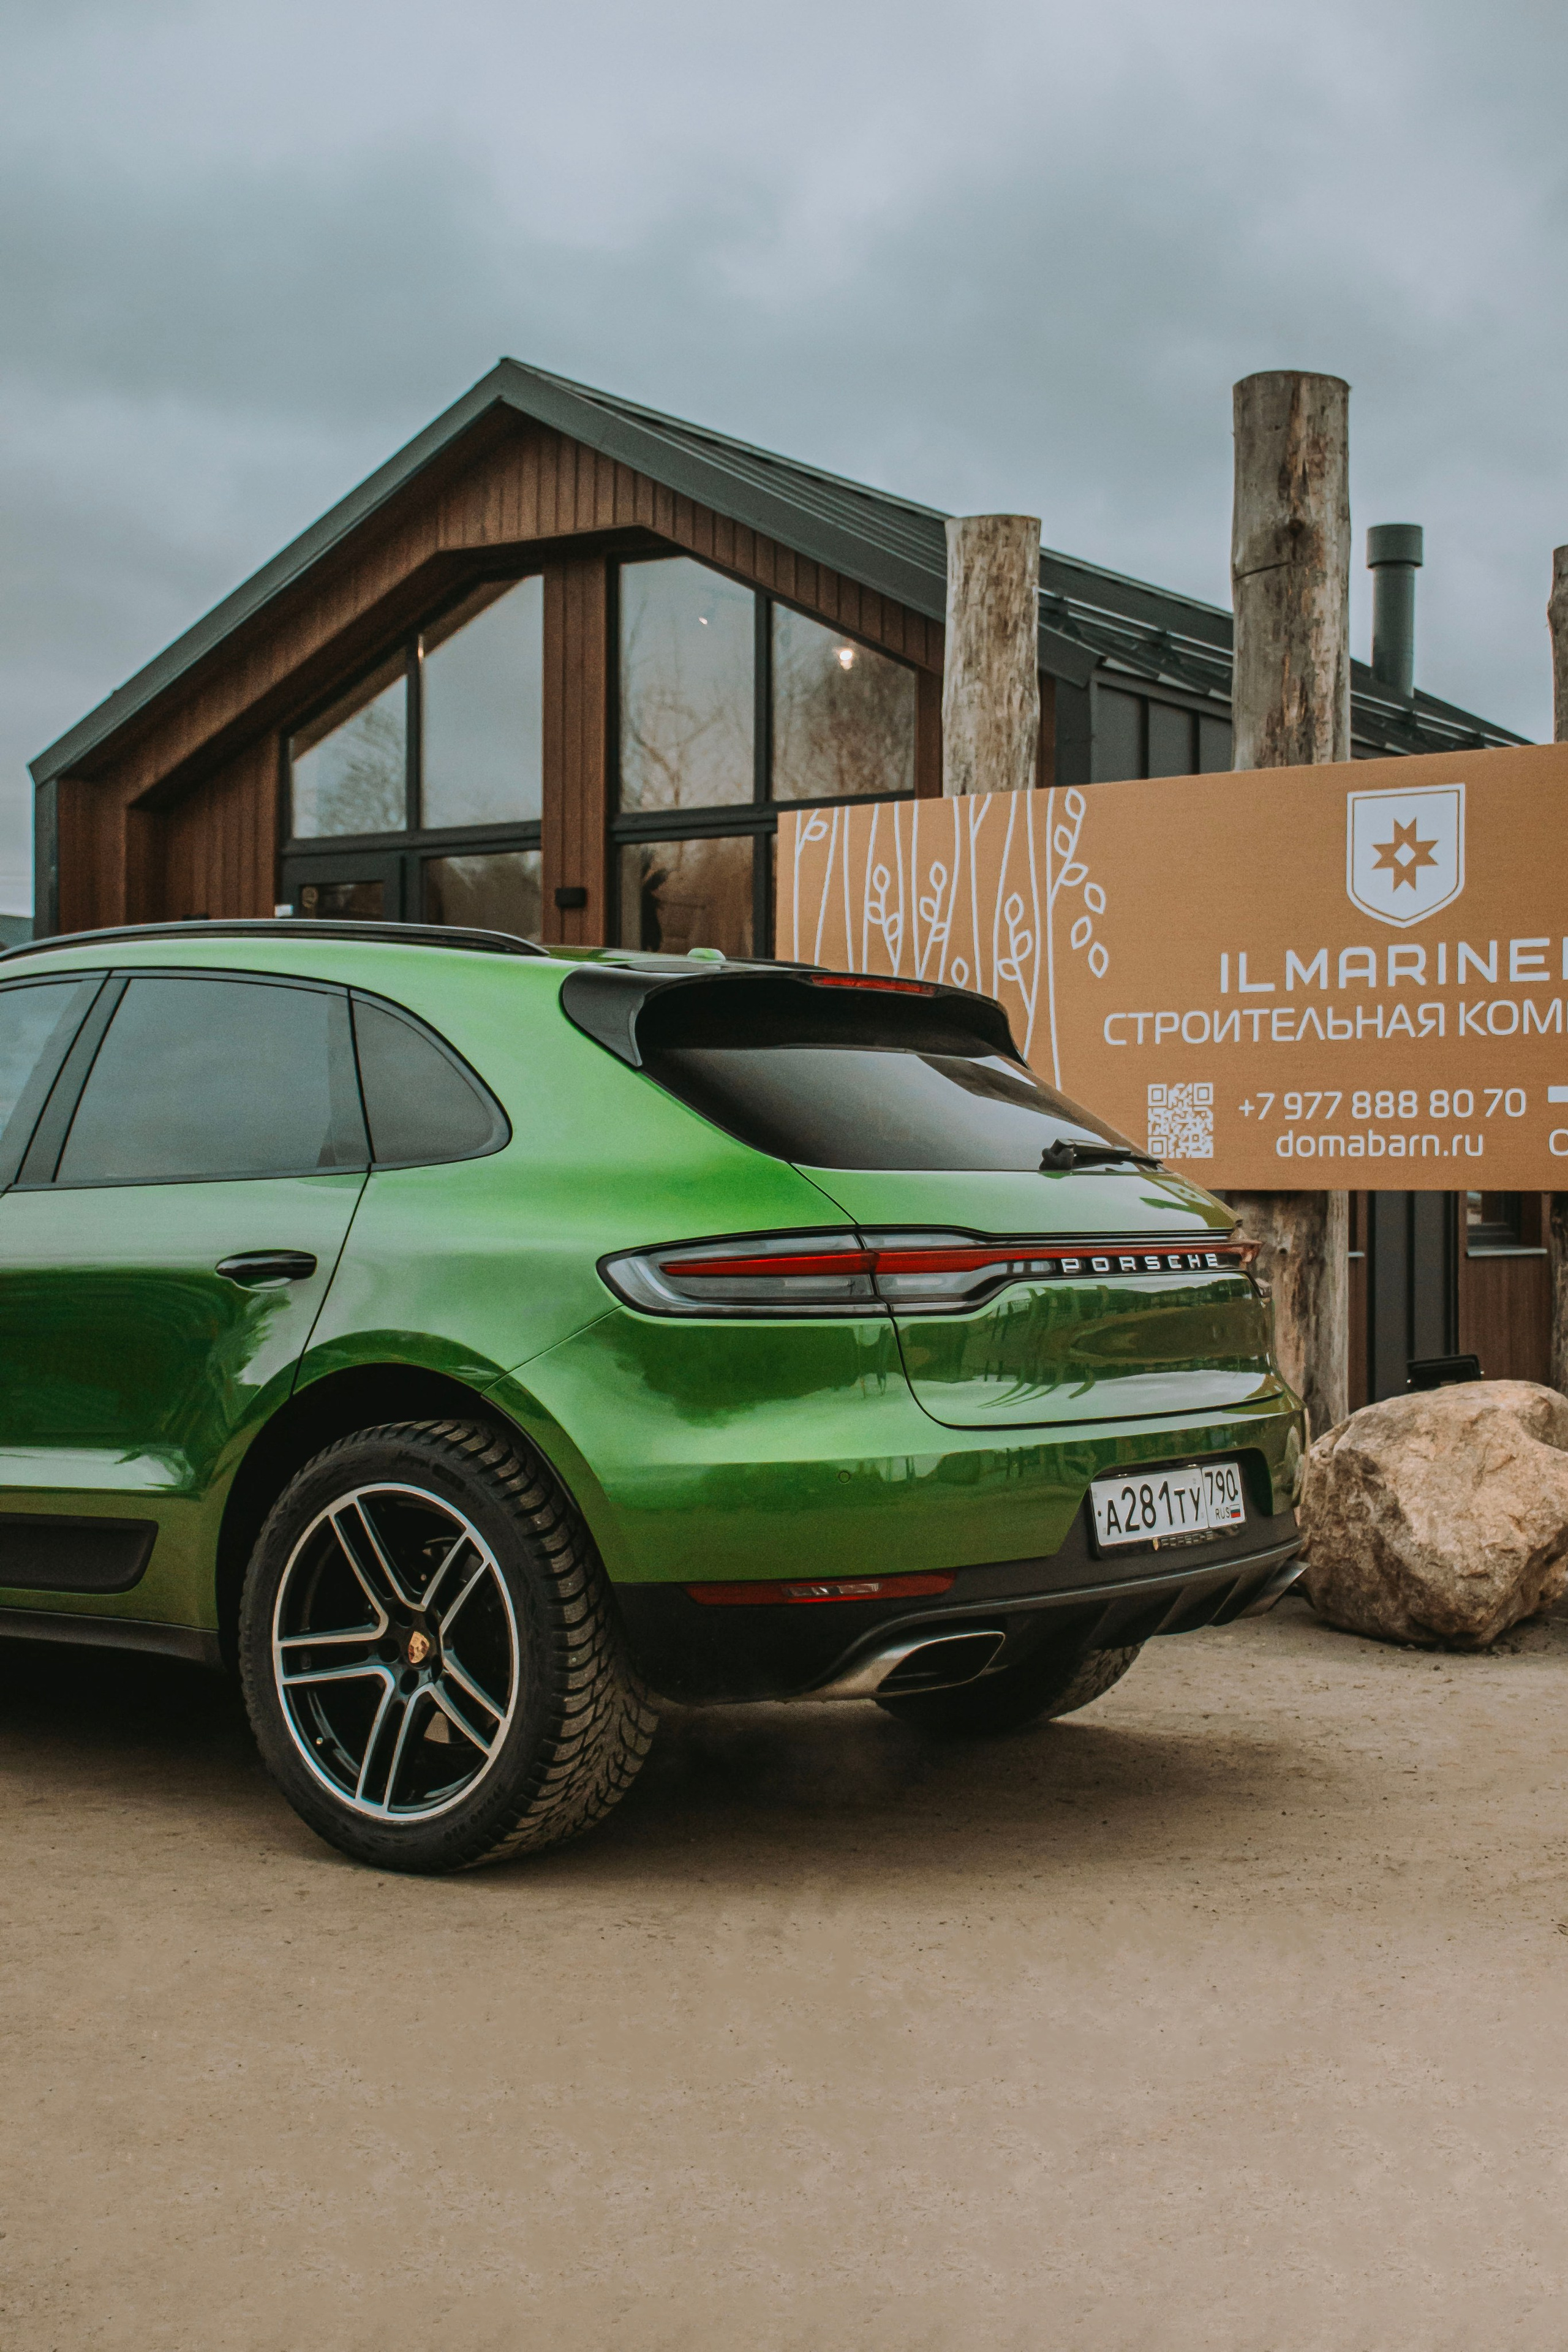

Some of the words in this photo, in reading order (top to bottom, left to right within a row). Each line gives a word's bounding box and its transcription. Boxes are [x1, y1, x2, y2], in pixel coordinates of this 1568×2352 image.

[1220, 936, 1568, 993] ILMARINE
[1103, 1002, 1445, 1046] СТРОИТЕЛЬНАЯ
[1458, 998, 1568, 1038] КОМ
[1238, 1092, 1275, 1120] +7
[1284, 1091, 1343, 1120] 977
[1351, 1090, 1418, 1119] 888
[1429, 1089, 1474, 1118] 80
[1483, 1088, 1526, 1117] 70
[1276, 1129, 1483, 1158] domabarn.ru
[1061, 1253, 1218, 1273] PORSCHE
[1204, 1469, 1236, 1506] 790
[1215, 1507, 1231, 1520] RUS
